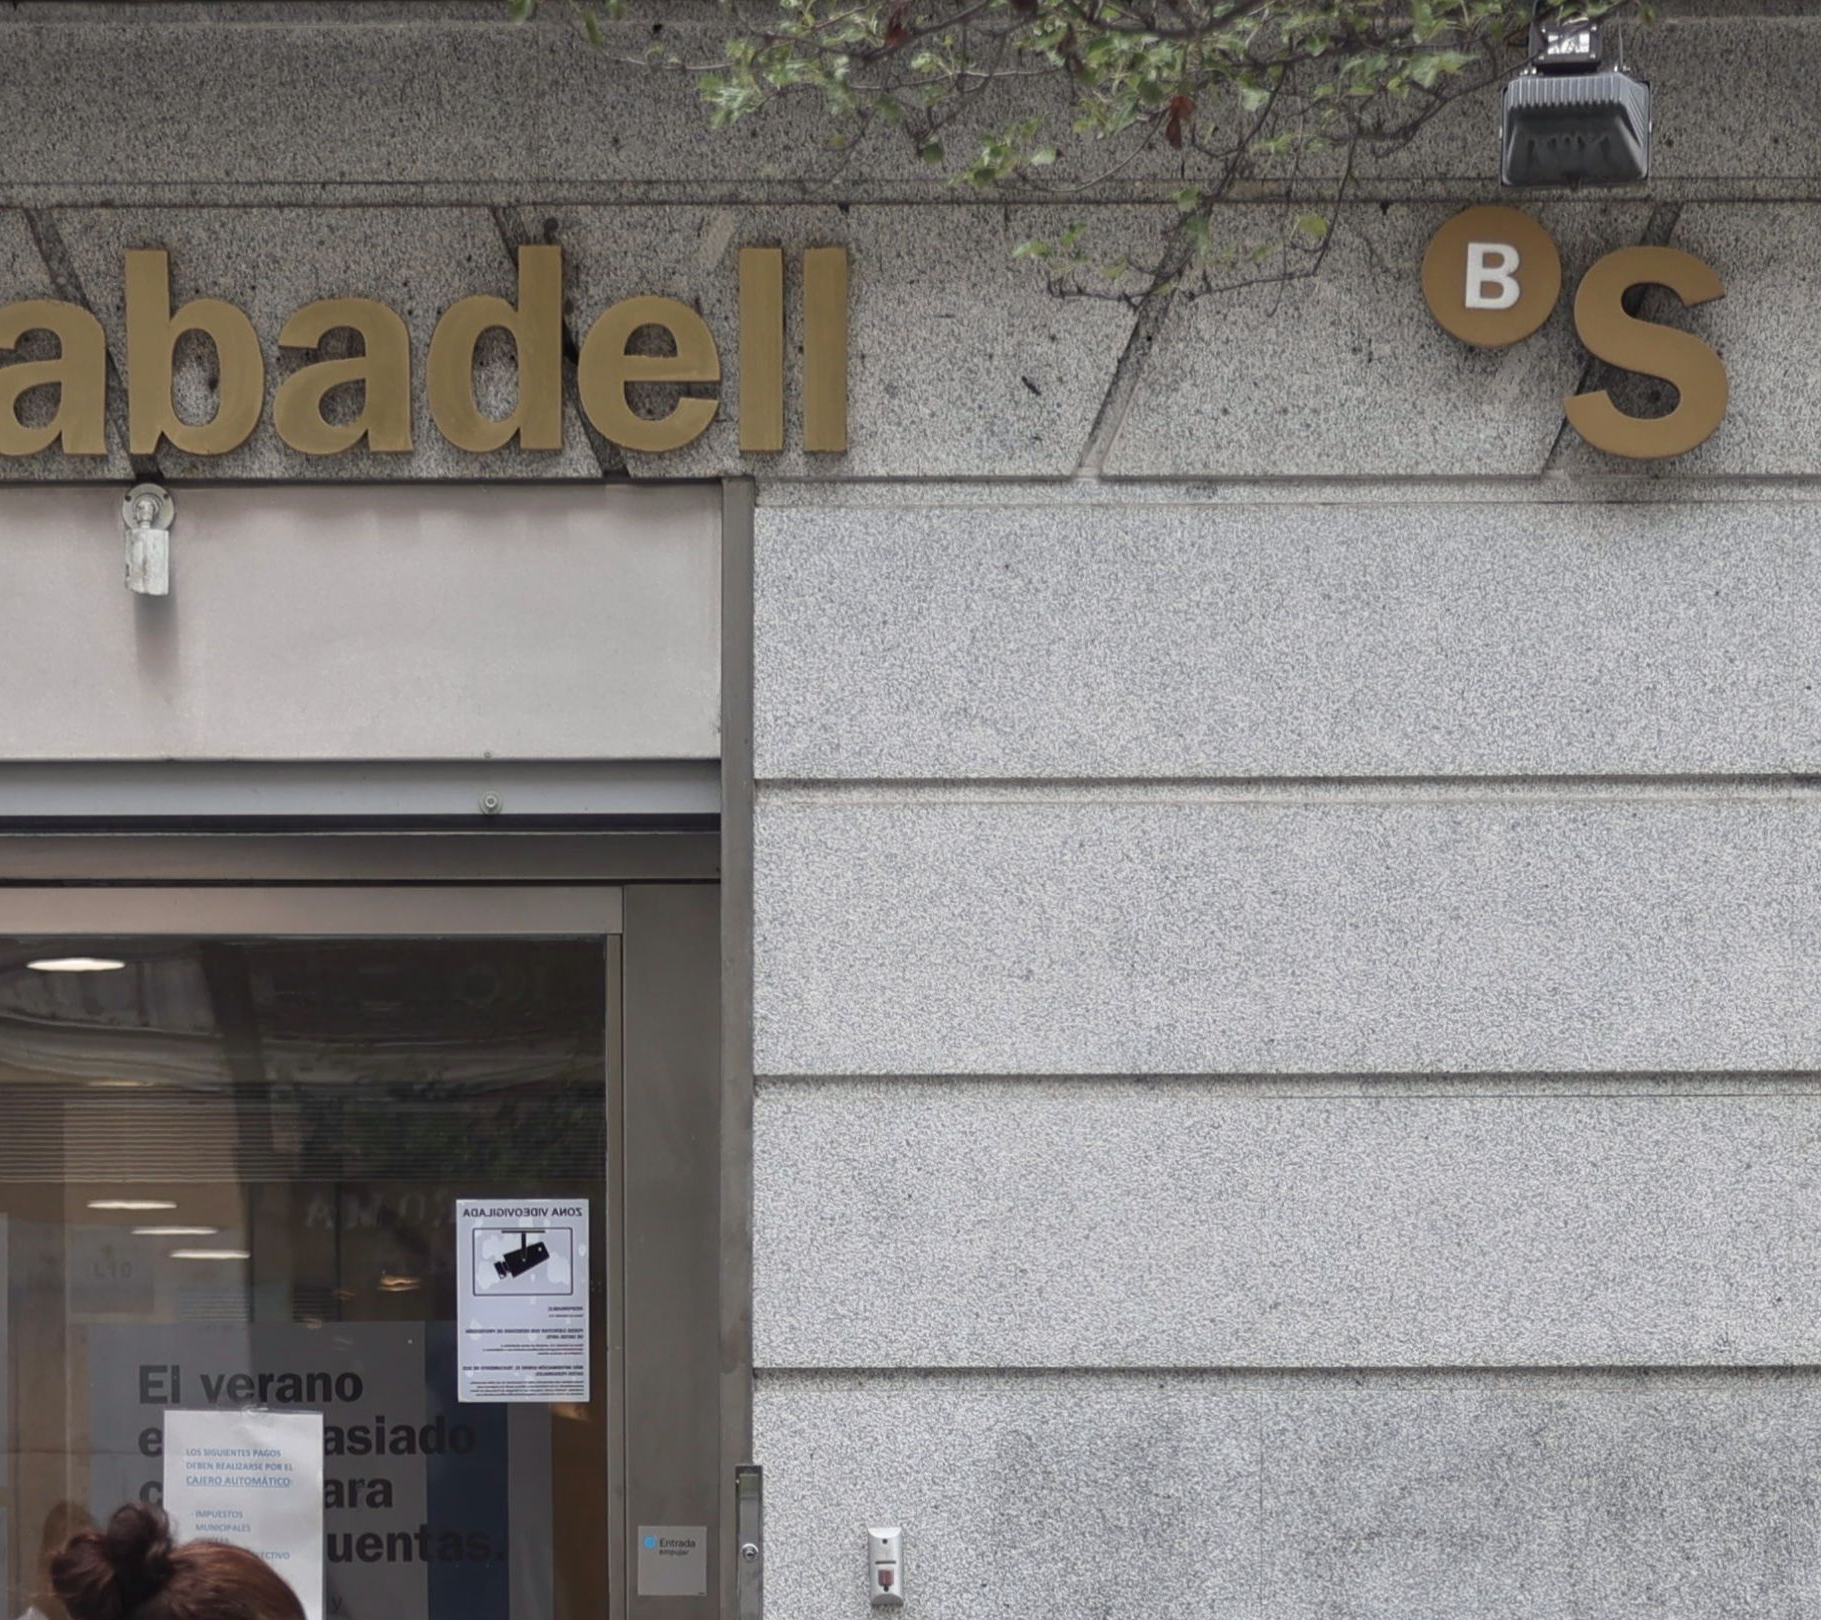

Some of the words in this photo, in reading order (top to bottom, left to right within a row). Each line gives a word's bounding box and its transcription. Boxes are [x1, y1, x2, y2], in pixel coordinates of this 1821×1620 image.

[1465, 242, 1521, 310] B
[1564, 245, 1729, 459] S
[139, 1364, 180, 1404] El
[200, 1370, 363, 1403] verano
[324, 1415, 477, 1458] asiado
[186, 1448, 202, 1457] LOS
[203, 1448, 251, 1457] SIGUIENTES
[253, 1449, 281, 1458] PAGOS
[186, 1461, 214, 1470] DEBEN
[216, 1462, 263, 1471] REALIZARSE
[265, 1463, 282, 1471] POR
[284, 1463, 293, 1471] EL
[186, 1475, 222, 1486] CAJERO
[324, 1477, 394, 1509] ara
[195, 1510, 243, 1518] IMPUESTOS
[195, 1524, 251, 1532] MUNICIPALES
[327, 1523, 505, 1563] uentas.
[659, 1538, 696, 1548] Entrada
[260, 1552, 291, 1560] ECTIVO
